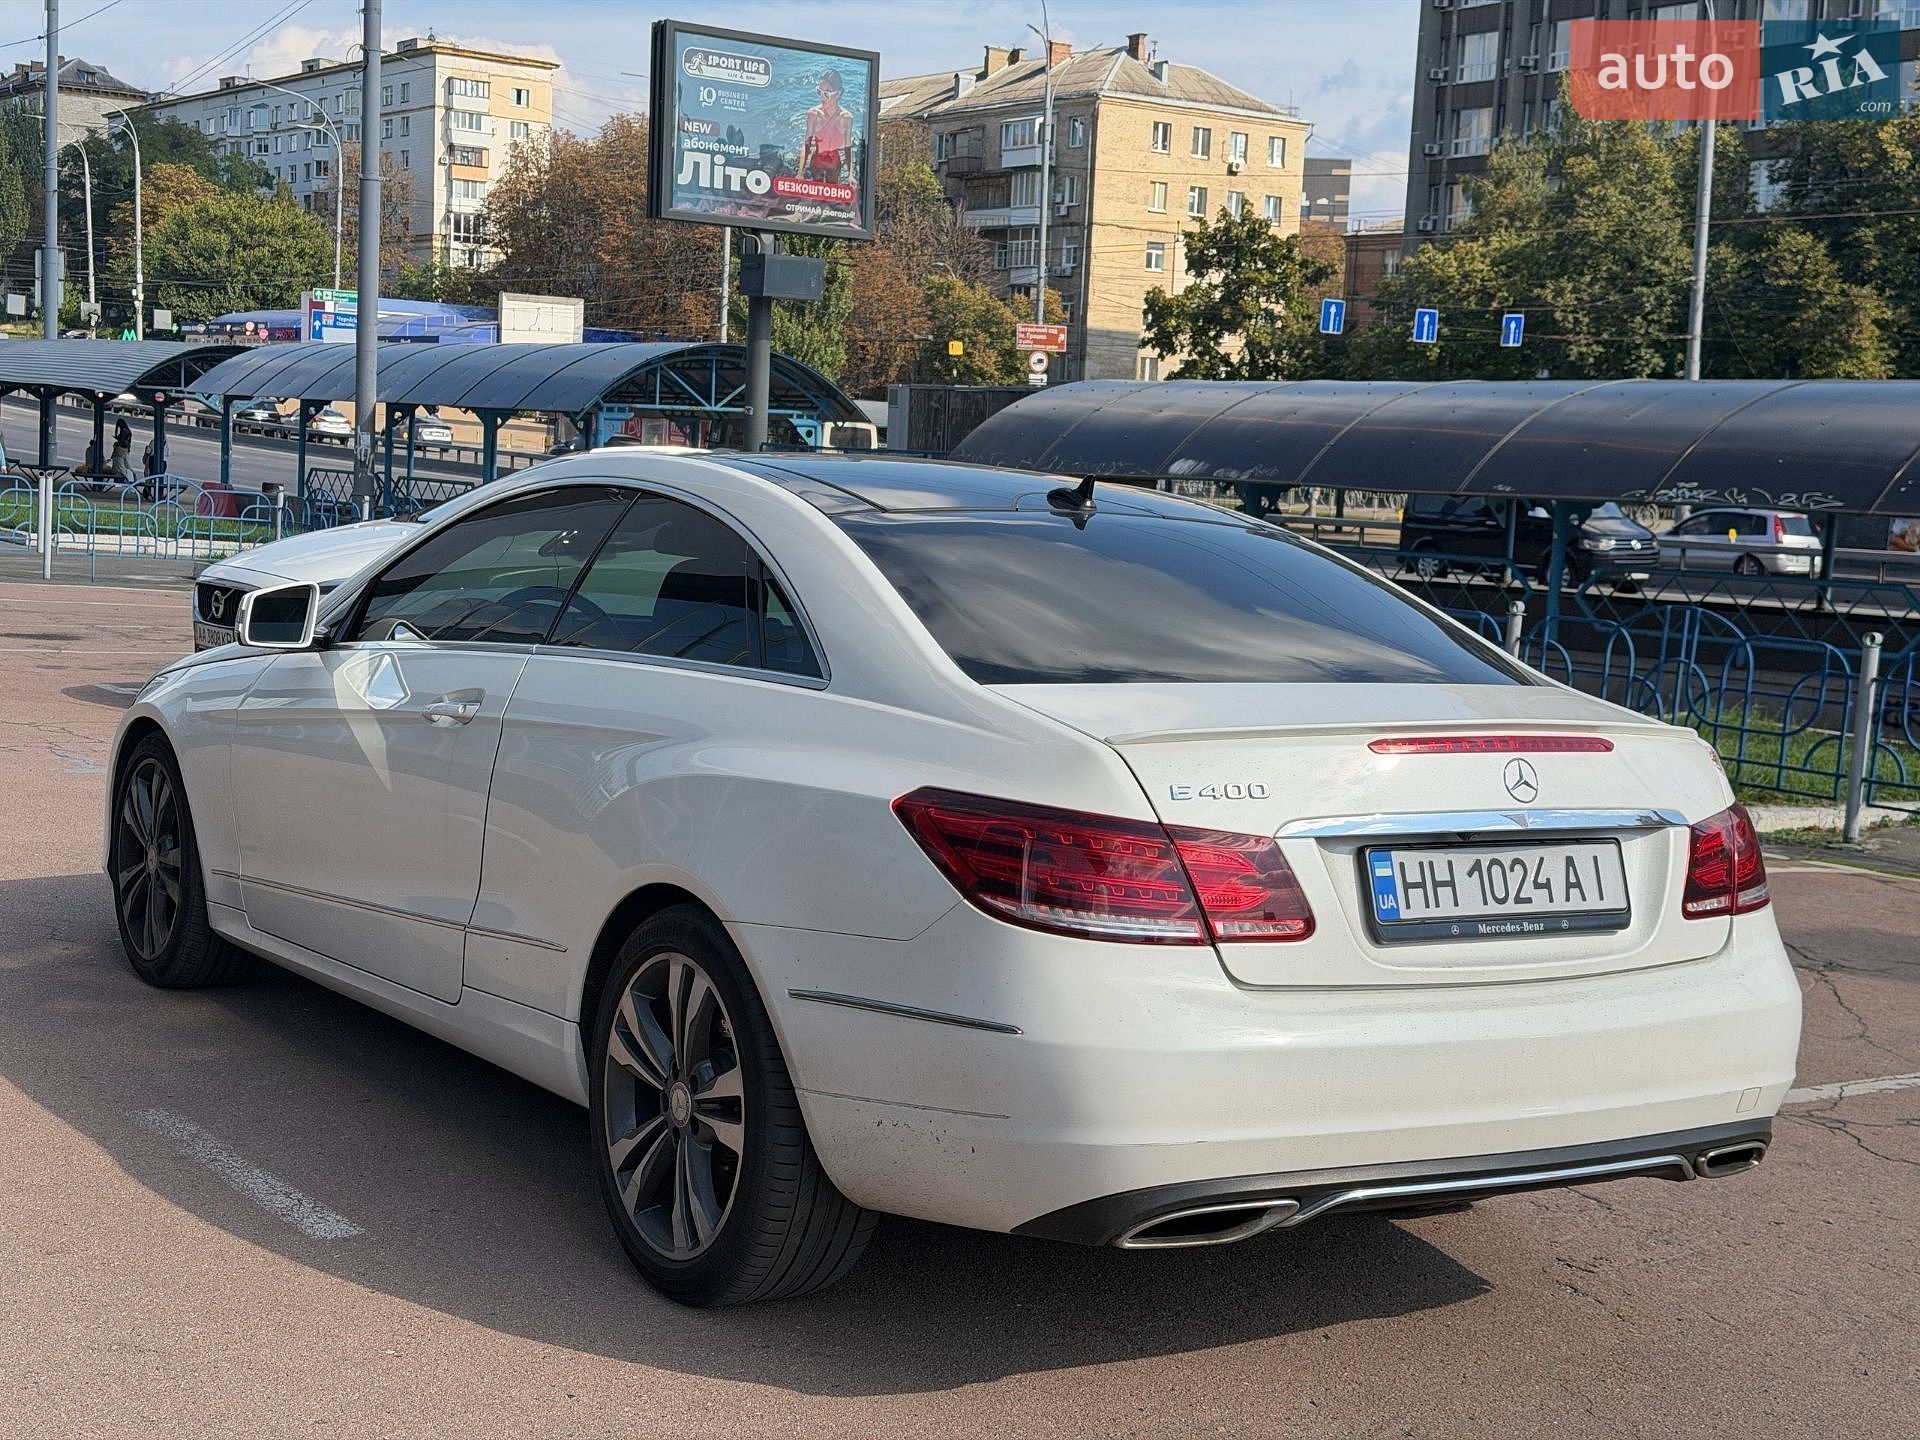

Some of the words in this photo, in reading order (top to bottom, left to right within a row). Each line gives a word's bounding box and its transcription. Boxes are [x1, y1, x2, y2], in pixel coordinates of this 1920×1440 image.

[707, 54, 742, 70] SPORT
[743, 60, 765, 74] LIFE
[717, 90, 749, 100] BUSINESS
[720, 97, 745, 107] CENTER
[684, 121, 711, 134] NEW
[684, 137, 750, 156] абонемент
[677, 151, 771, 194] Літо
[777, 181, 851, 199] БЕЗКОШТОВНО
[1169, 783, 1193, 801] E
[1198, 782, 1271, 801] 400
[1398, 859, 1459, 910] HH
[1466, 857, 1554, 906] 1024
[1379, 894, 1398, 910] UA
[1478, 922, 1544, 934] Mercedes-Benz
